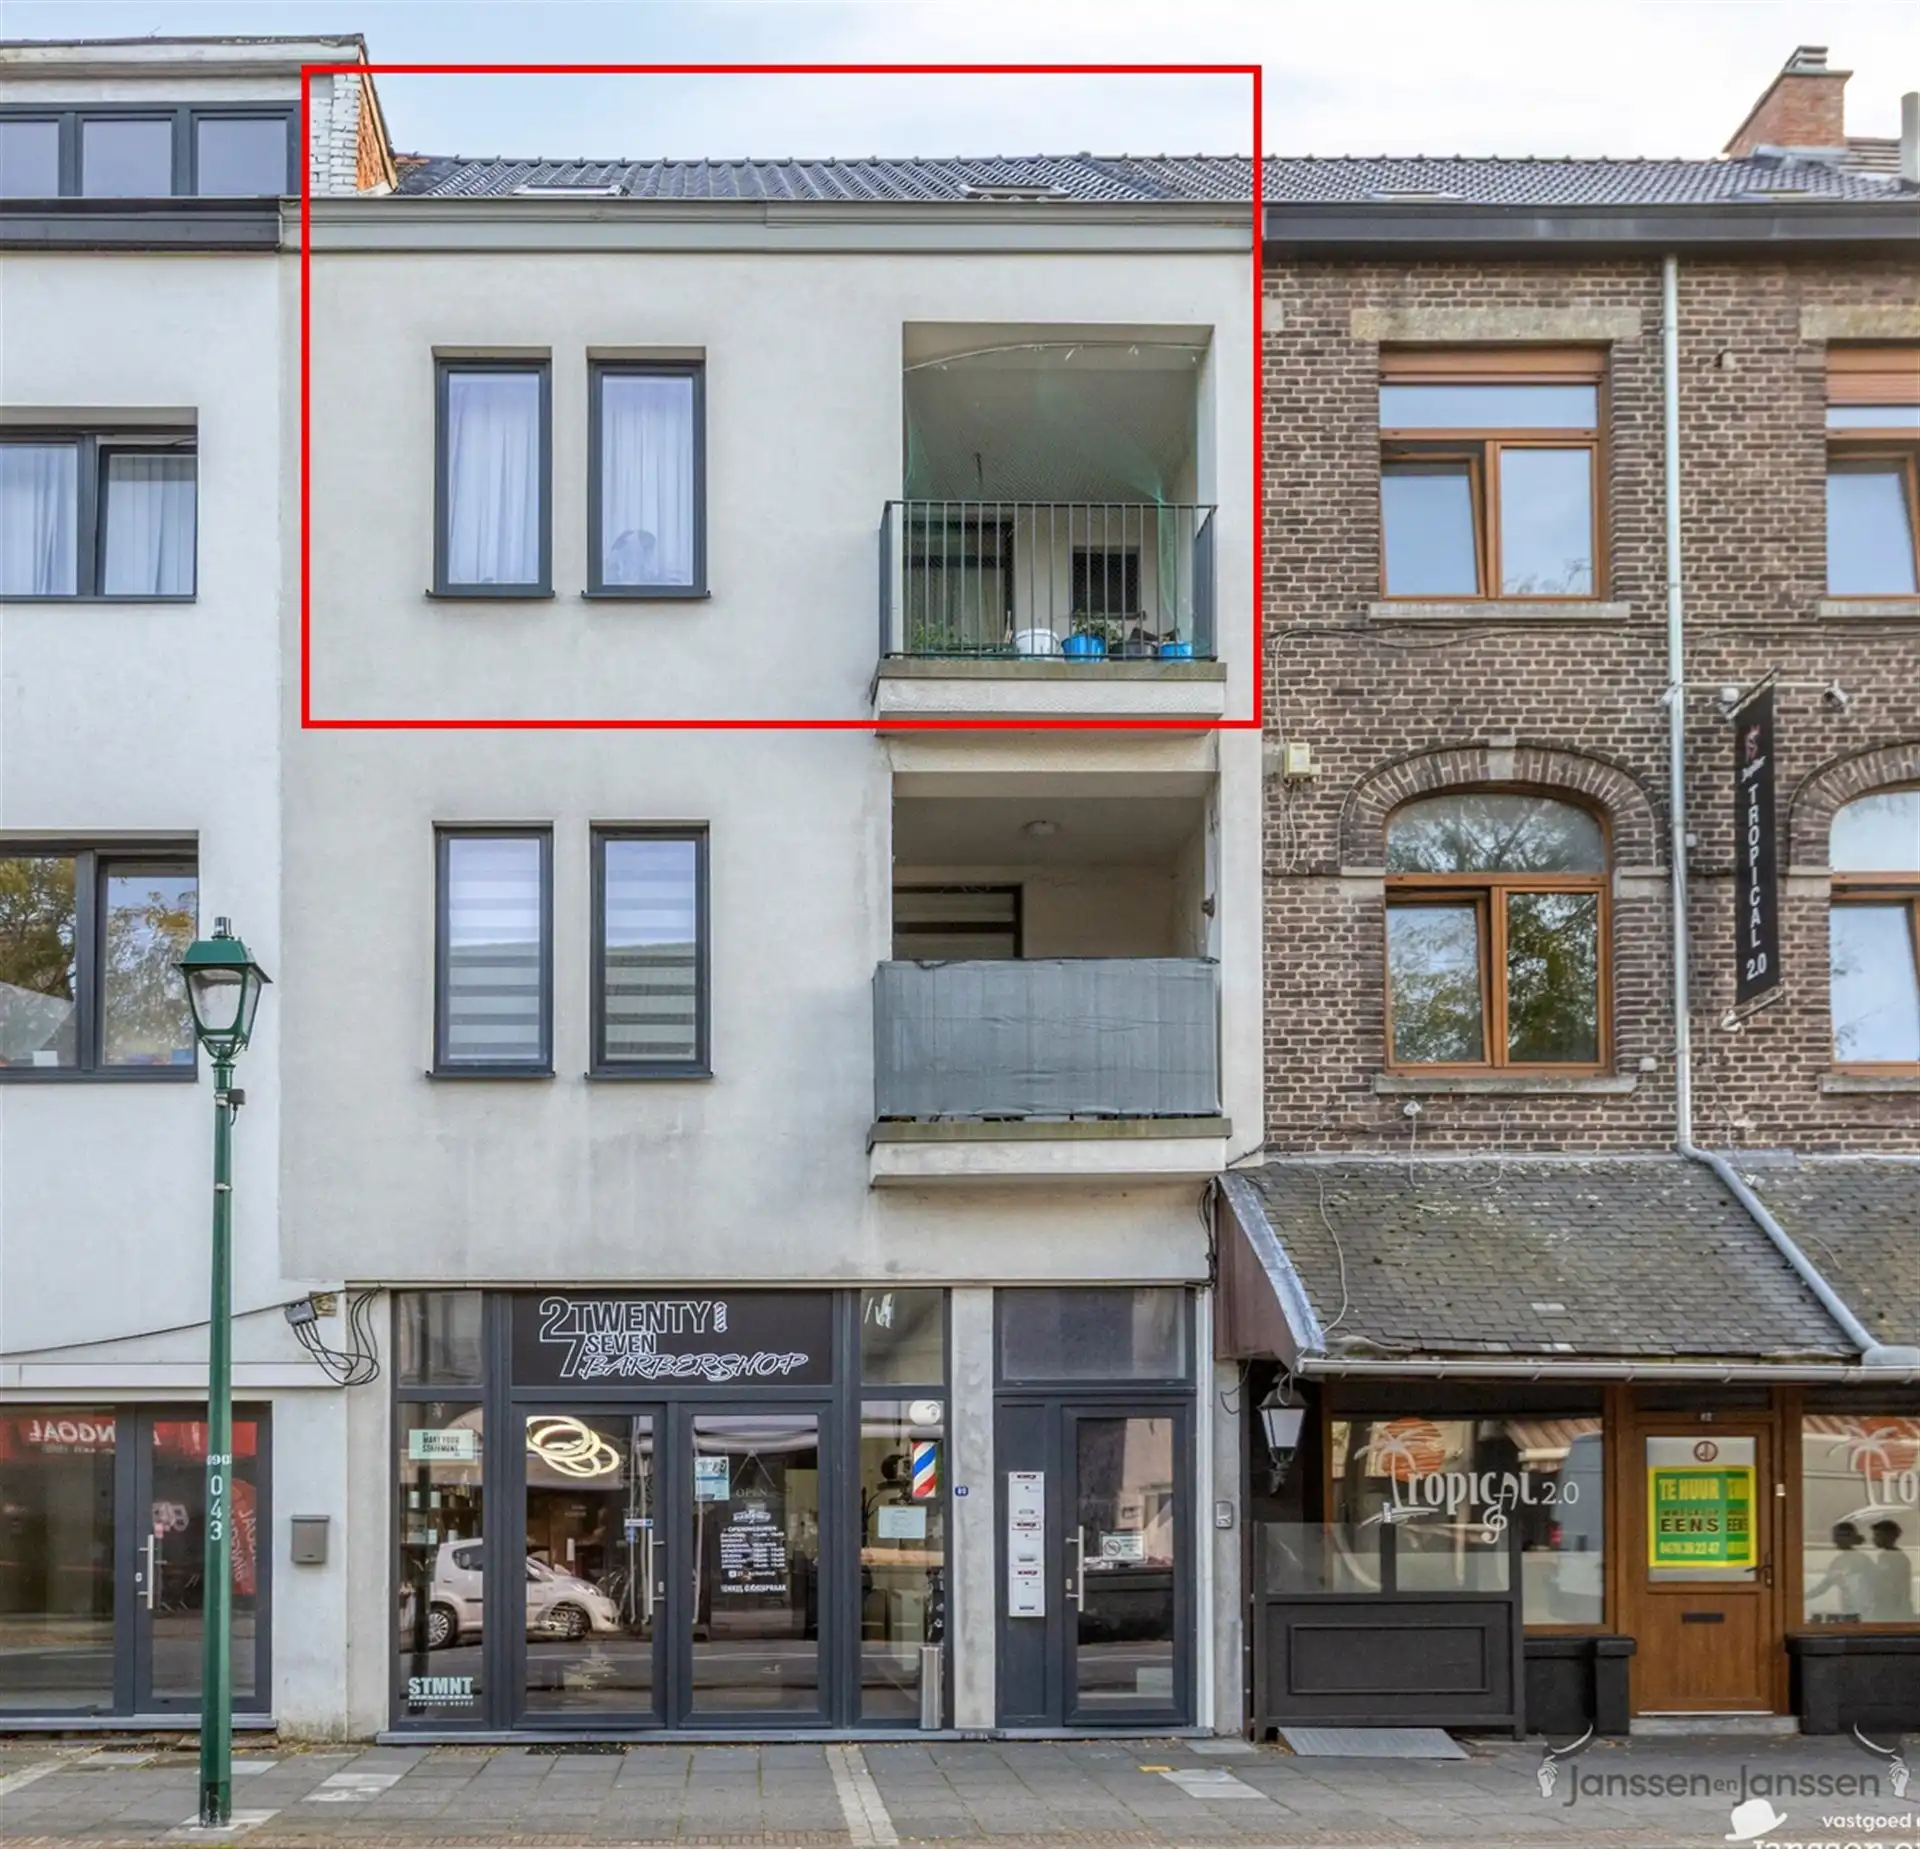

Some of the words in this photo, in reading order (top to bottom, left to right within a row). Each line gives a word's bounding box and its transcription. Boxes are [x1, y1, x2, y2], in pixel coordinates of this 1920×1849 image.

[1747, 783, 1762, 948] TROPICAL
[570, 1300, 712, 1333] TWENTY
[584, 1332, 657, 1355] SEVEN
[578, 1351, 809, 1382] BARBERSHOP
[1542, 1481, 1580, 1505] 2.0
[1659, 1479, 1677, 1500] TE
[1679, 1478, 1720, 1499] HUUR
[1660, 1518, 1720, 1533] EENS
[408, 1677, 474, 1694] STMNT
